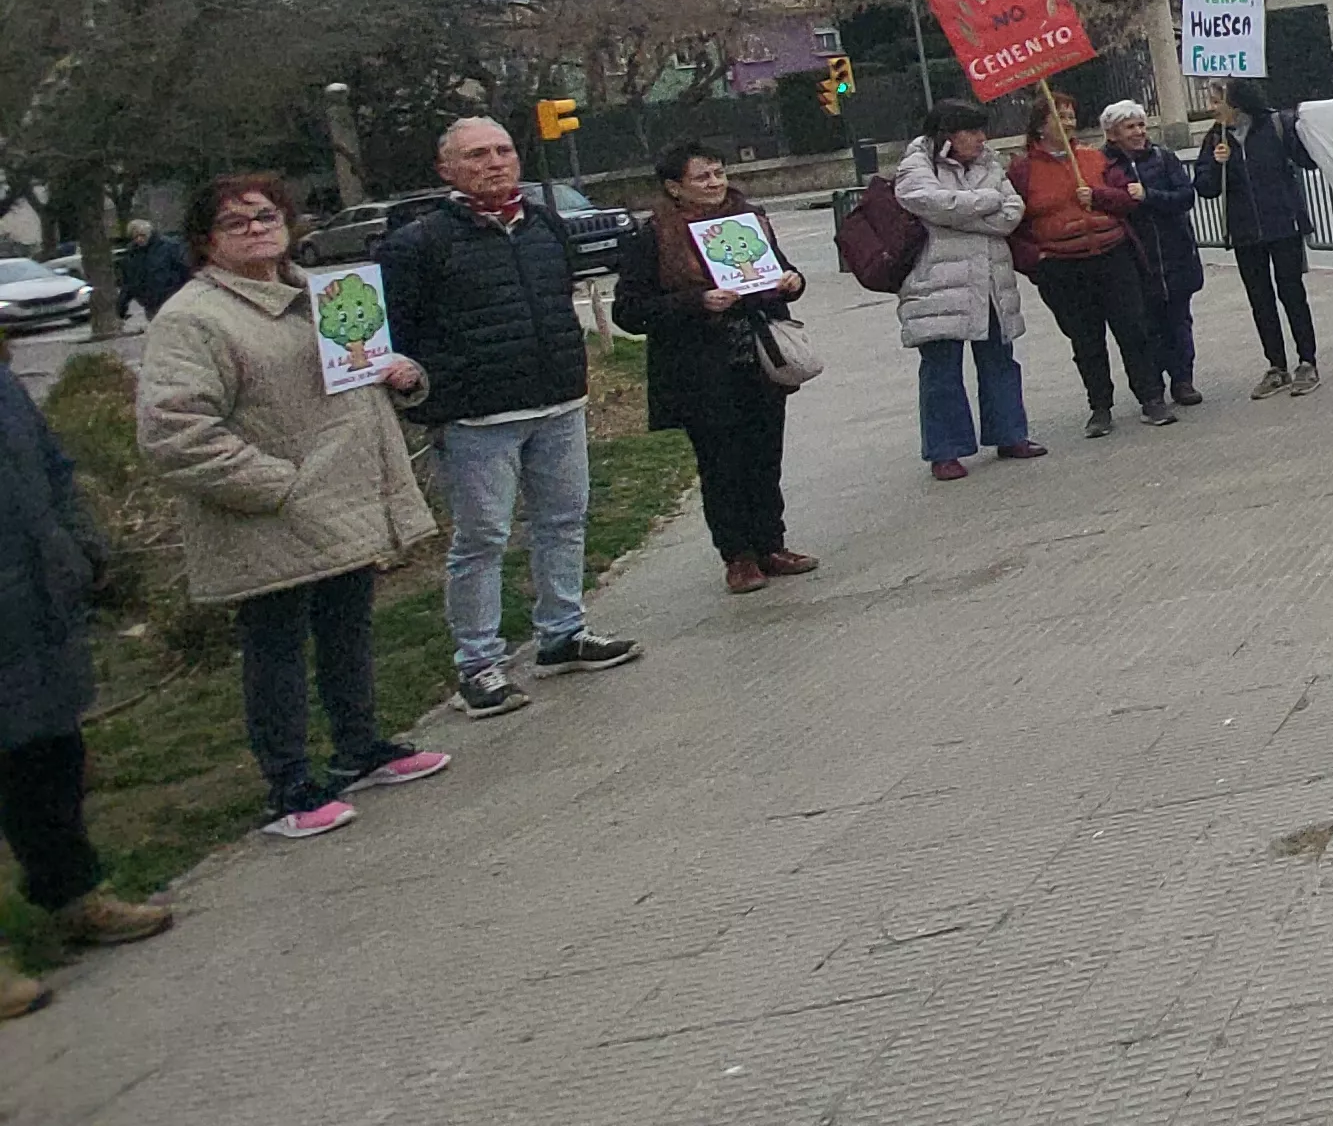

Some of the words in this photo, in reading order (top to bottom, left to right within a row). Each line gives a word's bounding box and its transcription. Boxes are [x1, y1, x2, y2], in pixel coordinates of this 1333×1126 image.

[991, 4, 1026, 31] NO
[1191, 11, 1251, 38] HUESCA
[1193, 45, 1247, 72] FUERTE
